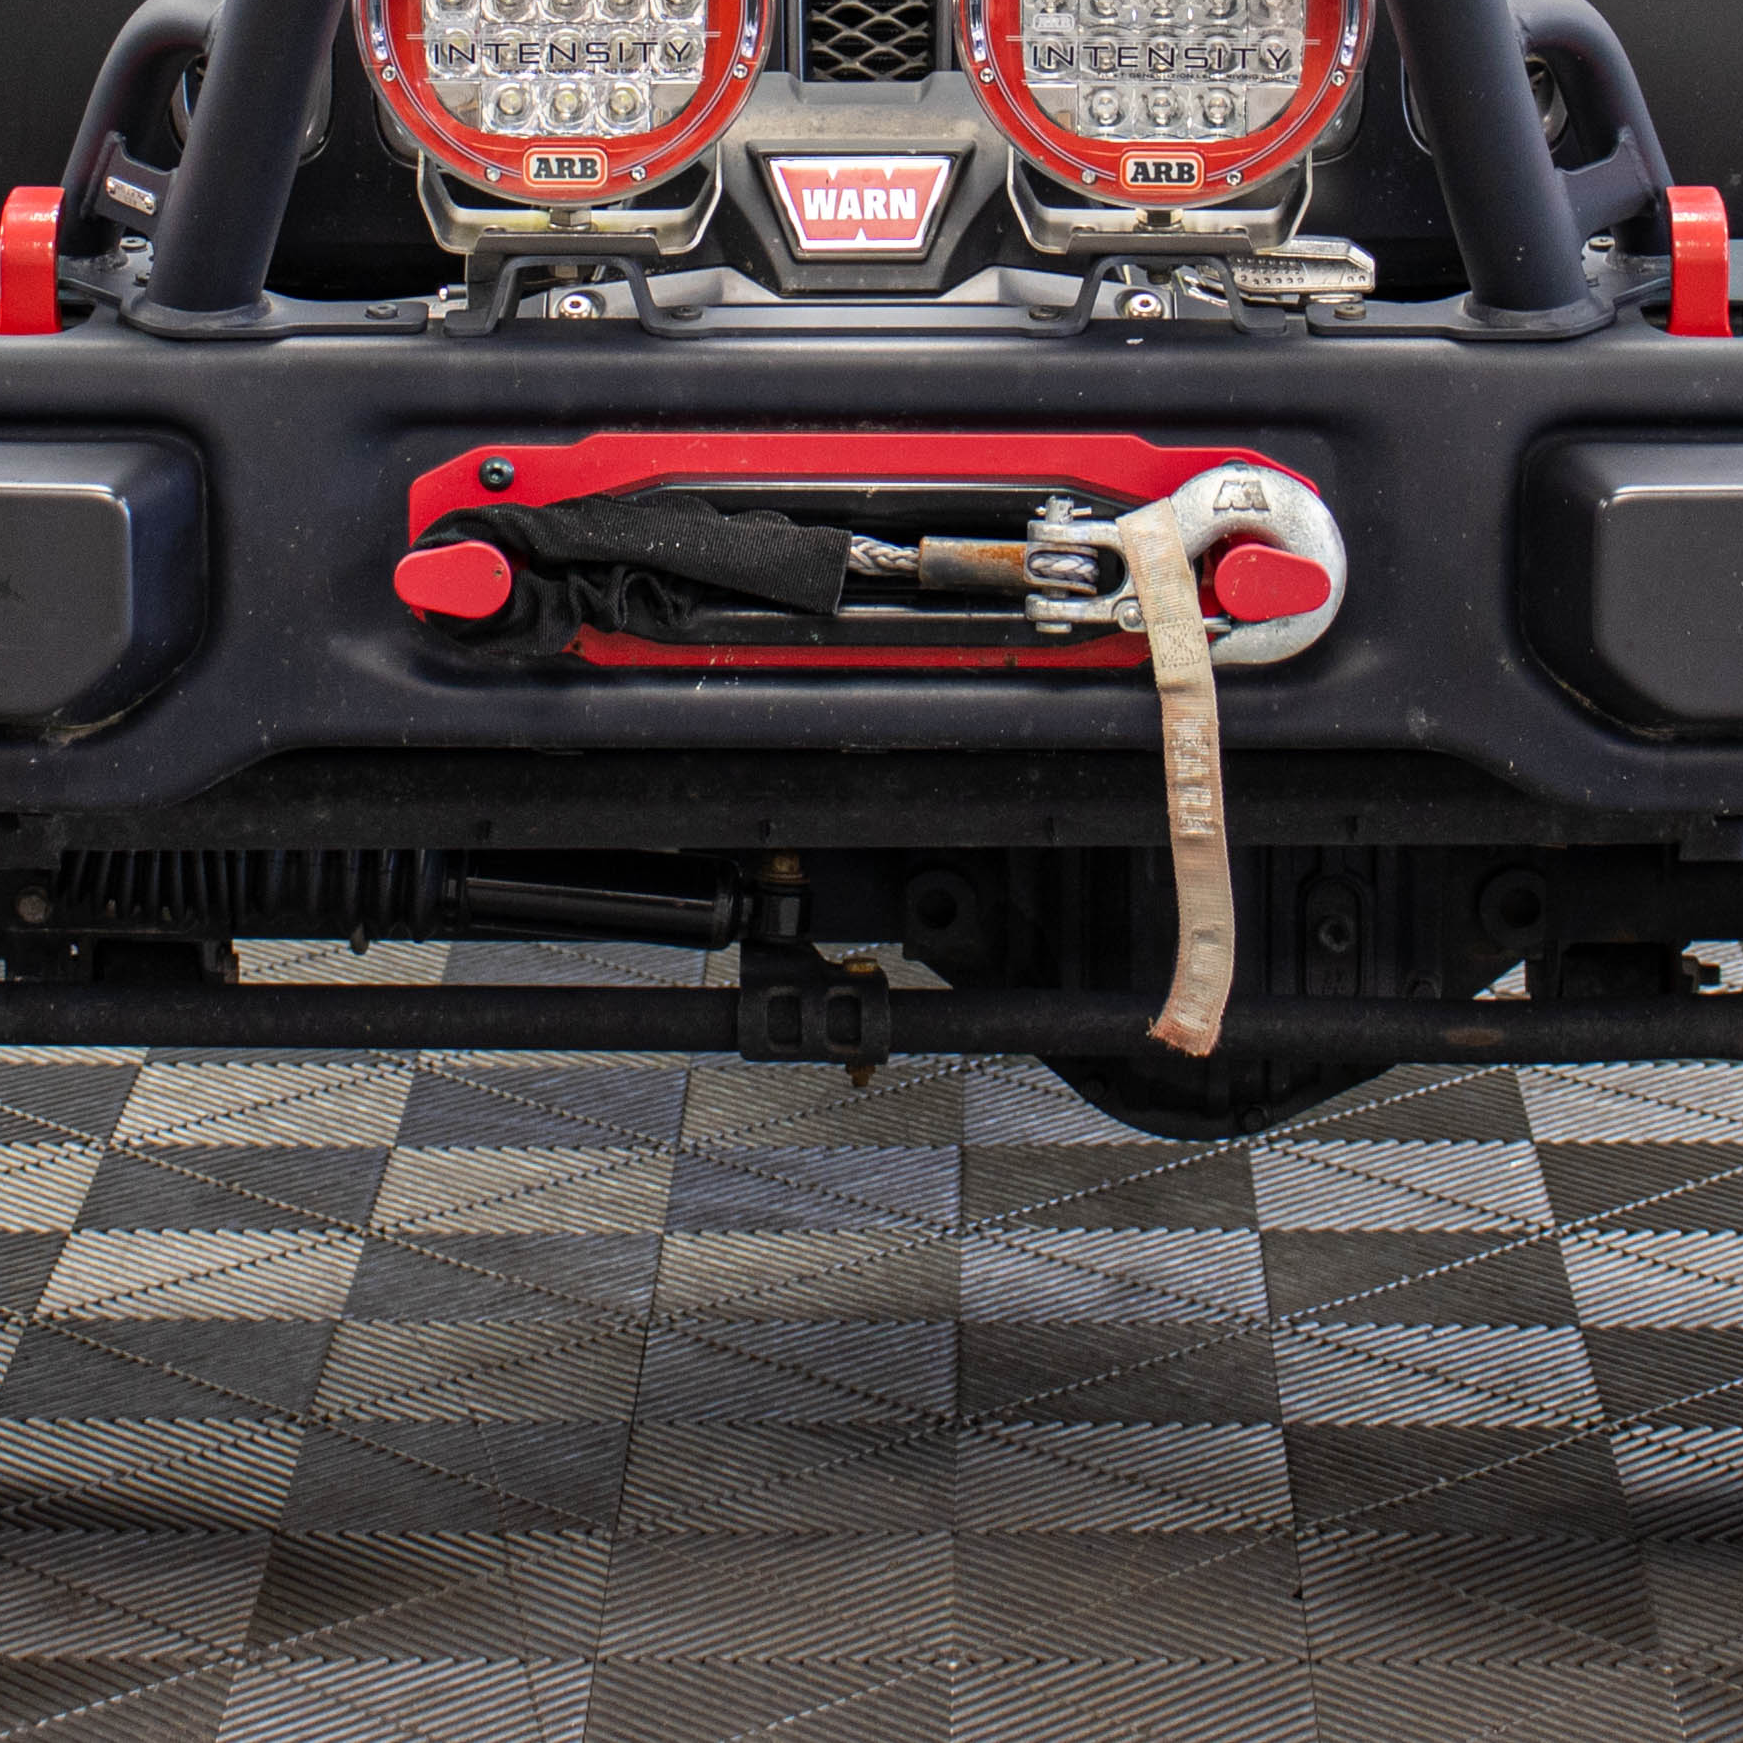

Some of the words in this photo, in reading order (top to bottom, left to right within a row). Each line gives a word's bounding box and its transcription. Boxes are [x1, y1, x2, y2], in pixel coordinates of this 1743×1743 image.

[434, 40, 691, 64] INTENSITY
[1032, 45, 1291, 69] INTENSITY
[533, 157, 599, 179] ARB
[1130, 161, 1196, 183] ARB
[801, 187, 917, 221] WARN
